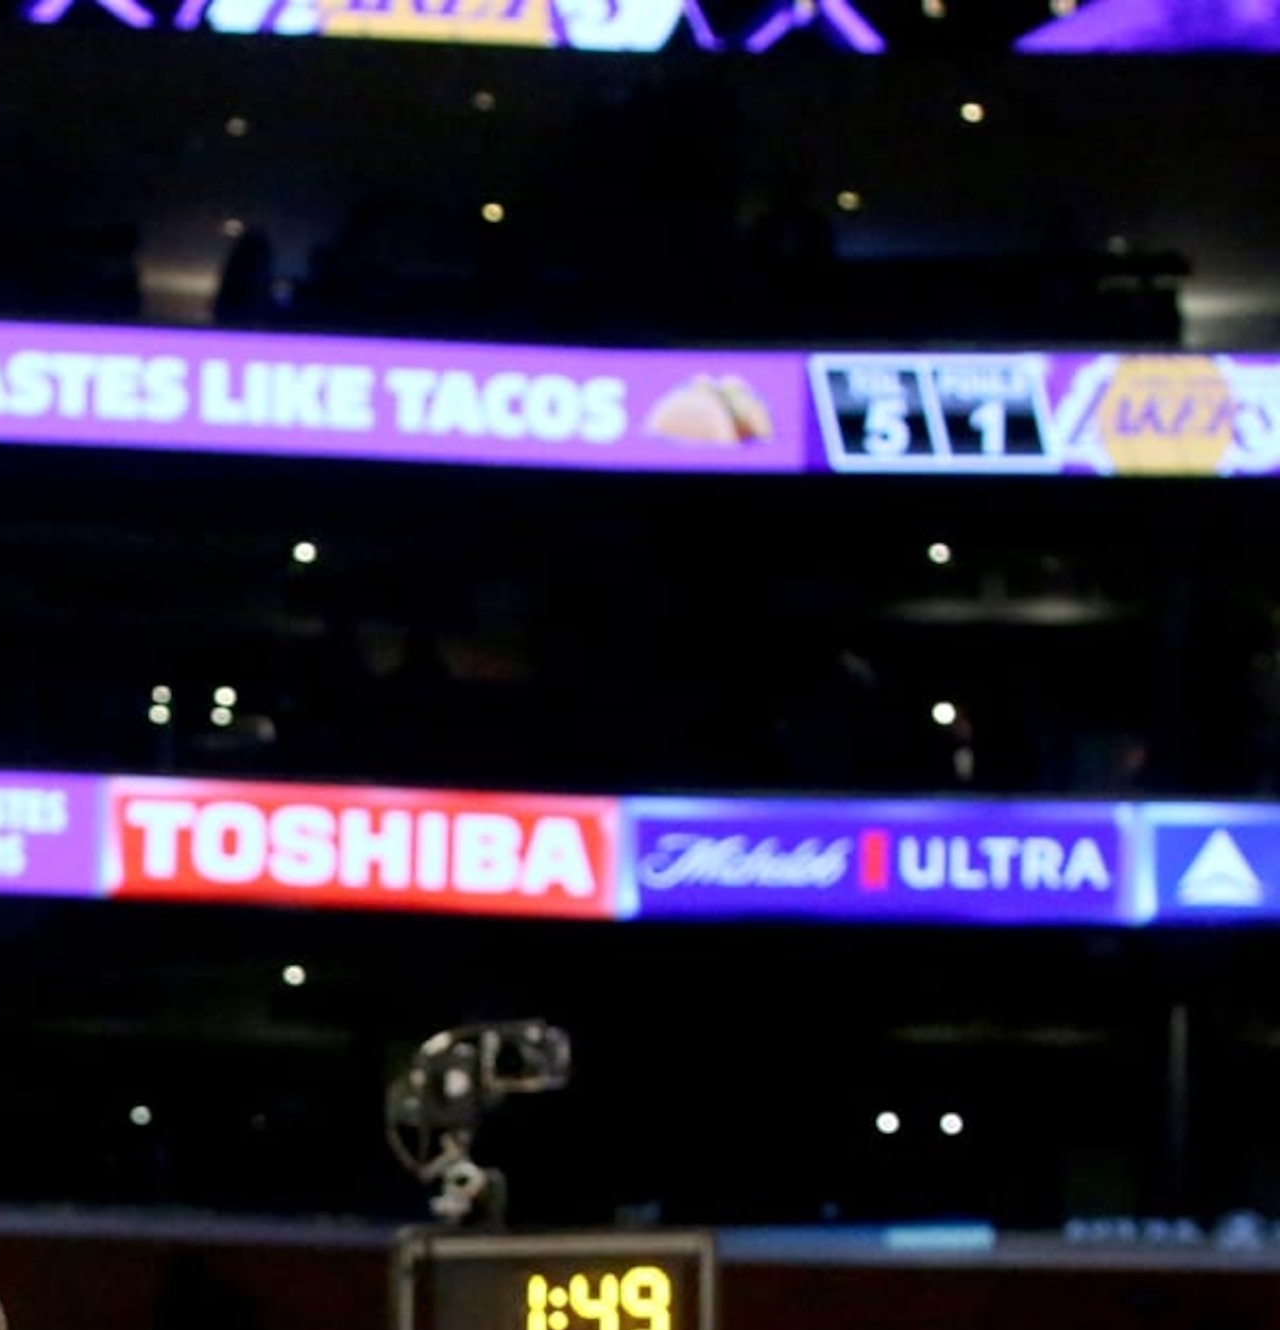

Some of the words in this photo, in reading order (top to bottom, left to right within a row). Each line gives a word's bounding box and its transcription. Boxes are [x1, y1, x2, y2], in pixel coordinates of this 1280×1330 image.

[199, 359, 375, 431] LIKE
[385, 368, 628, 444] TACOS
[125, 800, 597, 898] TOSHIBA
[898, 836, 1111, 891] ULTRA
